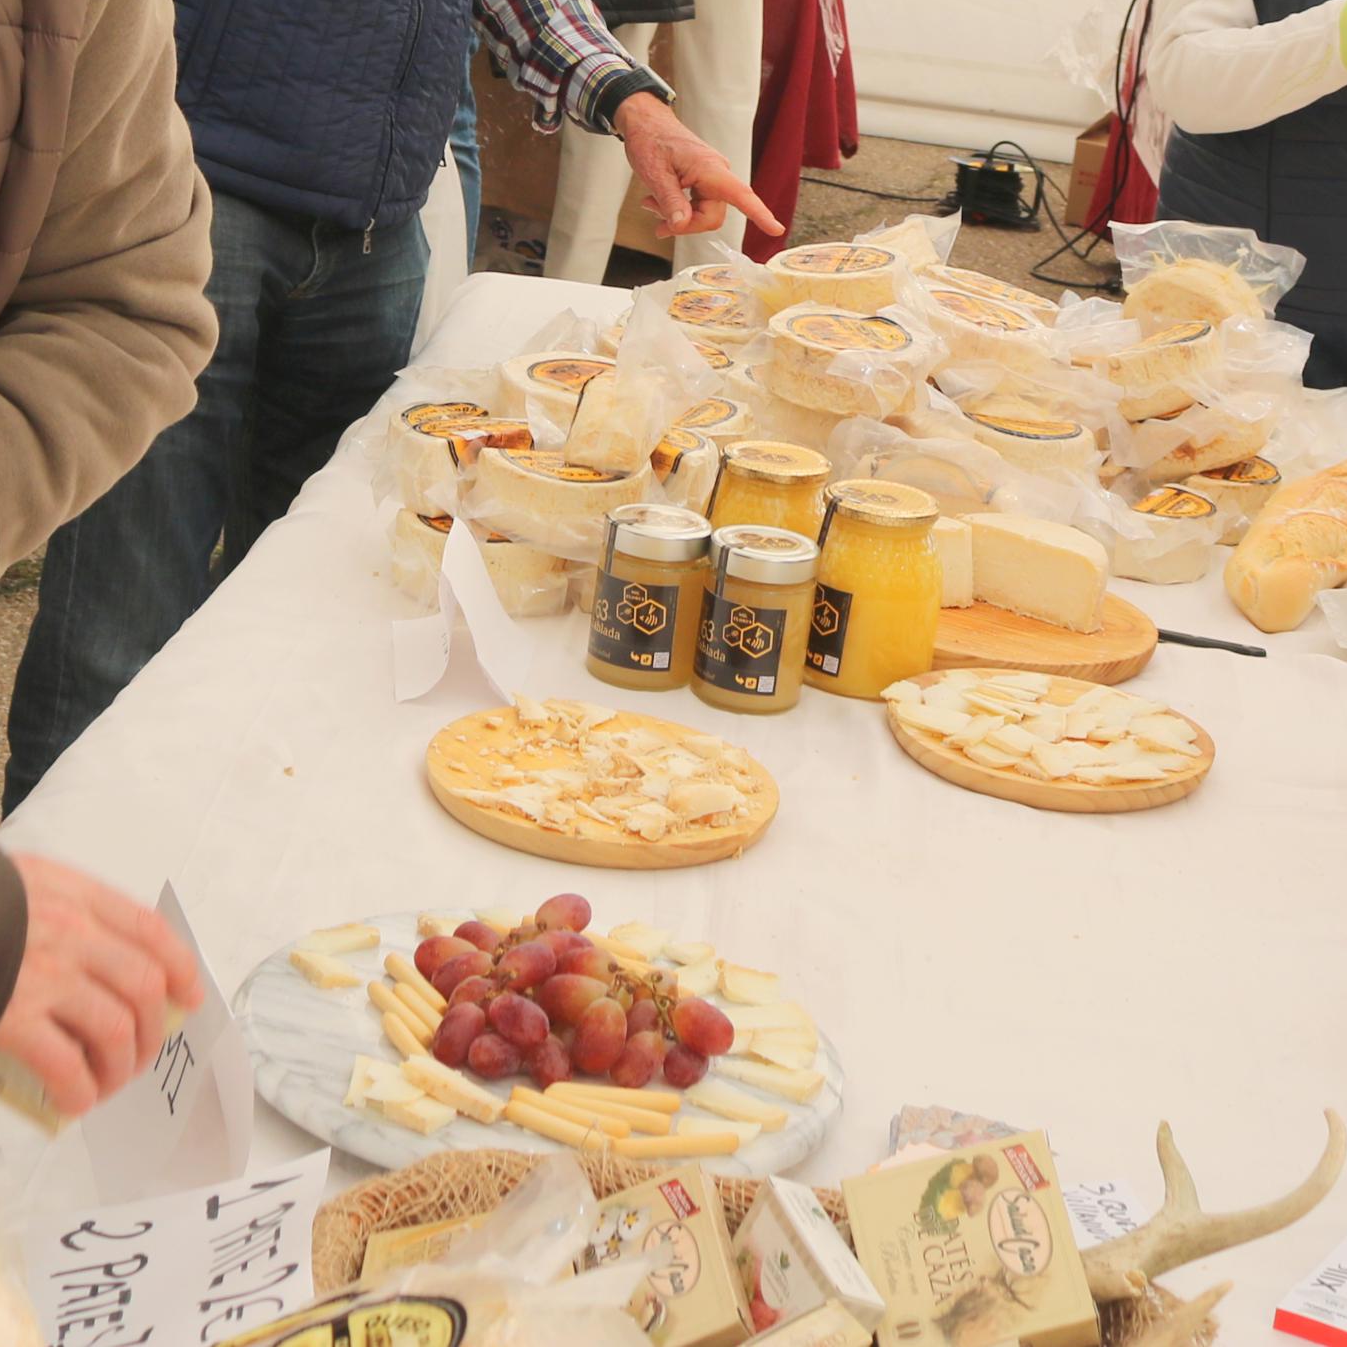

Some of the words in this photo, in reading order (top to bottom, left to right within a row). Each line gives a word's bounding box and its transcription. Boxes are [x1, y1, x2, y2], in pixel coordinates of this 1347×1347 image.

[206, 1173, 304, 1221] 1
[59, 1219, 154, 1252] 2
[922, 1242, 954, 1306] CAZA
